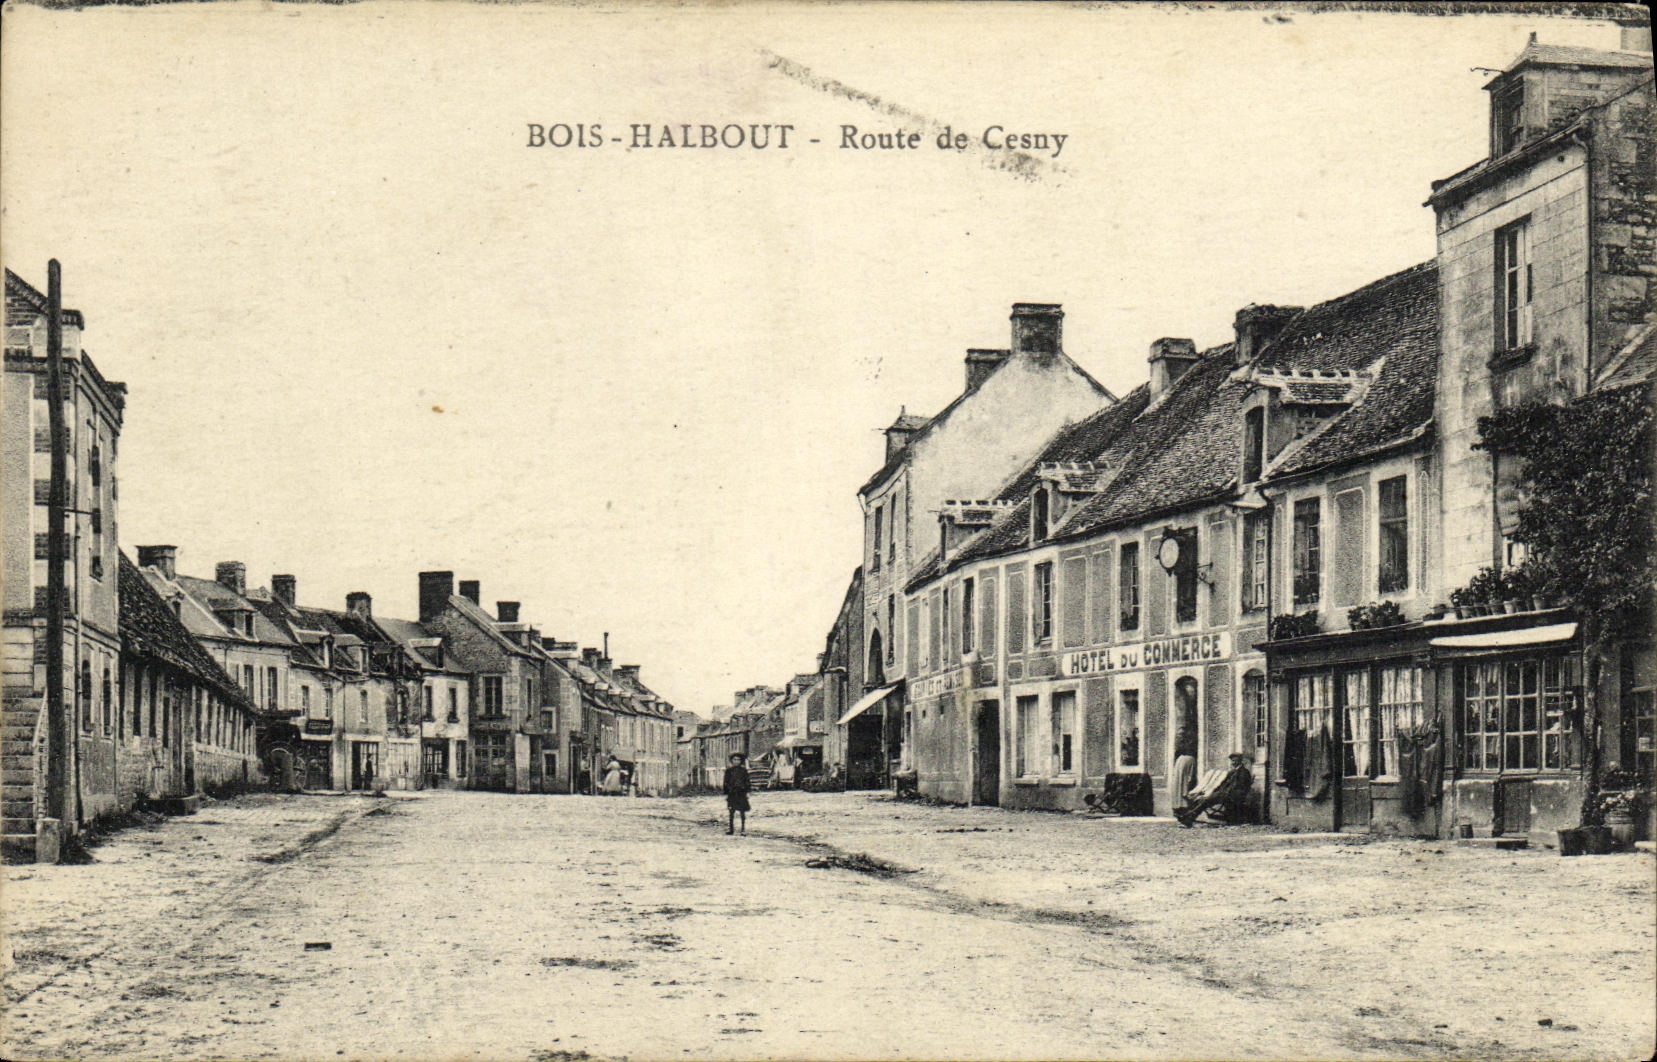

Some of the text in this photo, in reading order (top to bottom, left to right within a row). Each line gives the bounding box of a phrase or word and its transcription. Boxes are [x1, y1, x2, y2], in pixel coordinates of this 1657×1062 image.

[1070, 635, 1221, 674] HOTEL DU COMMERCE
